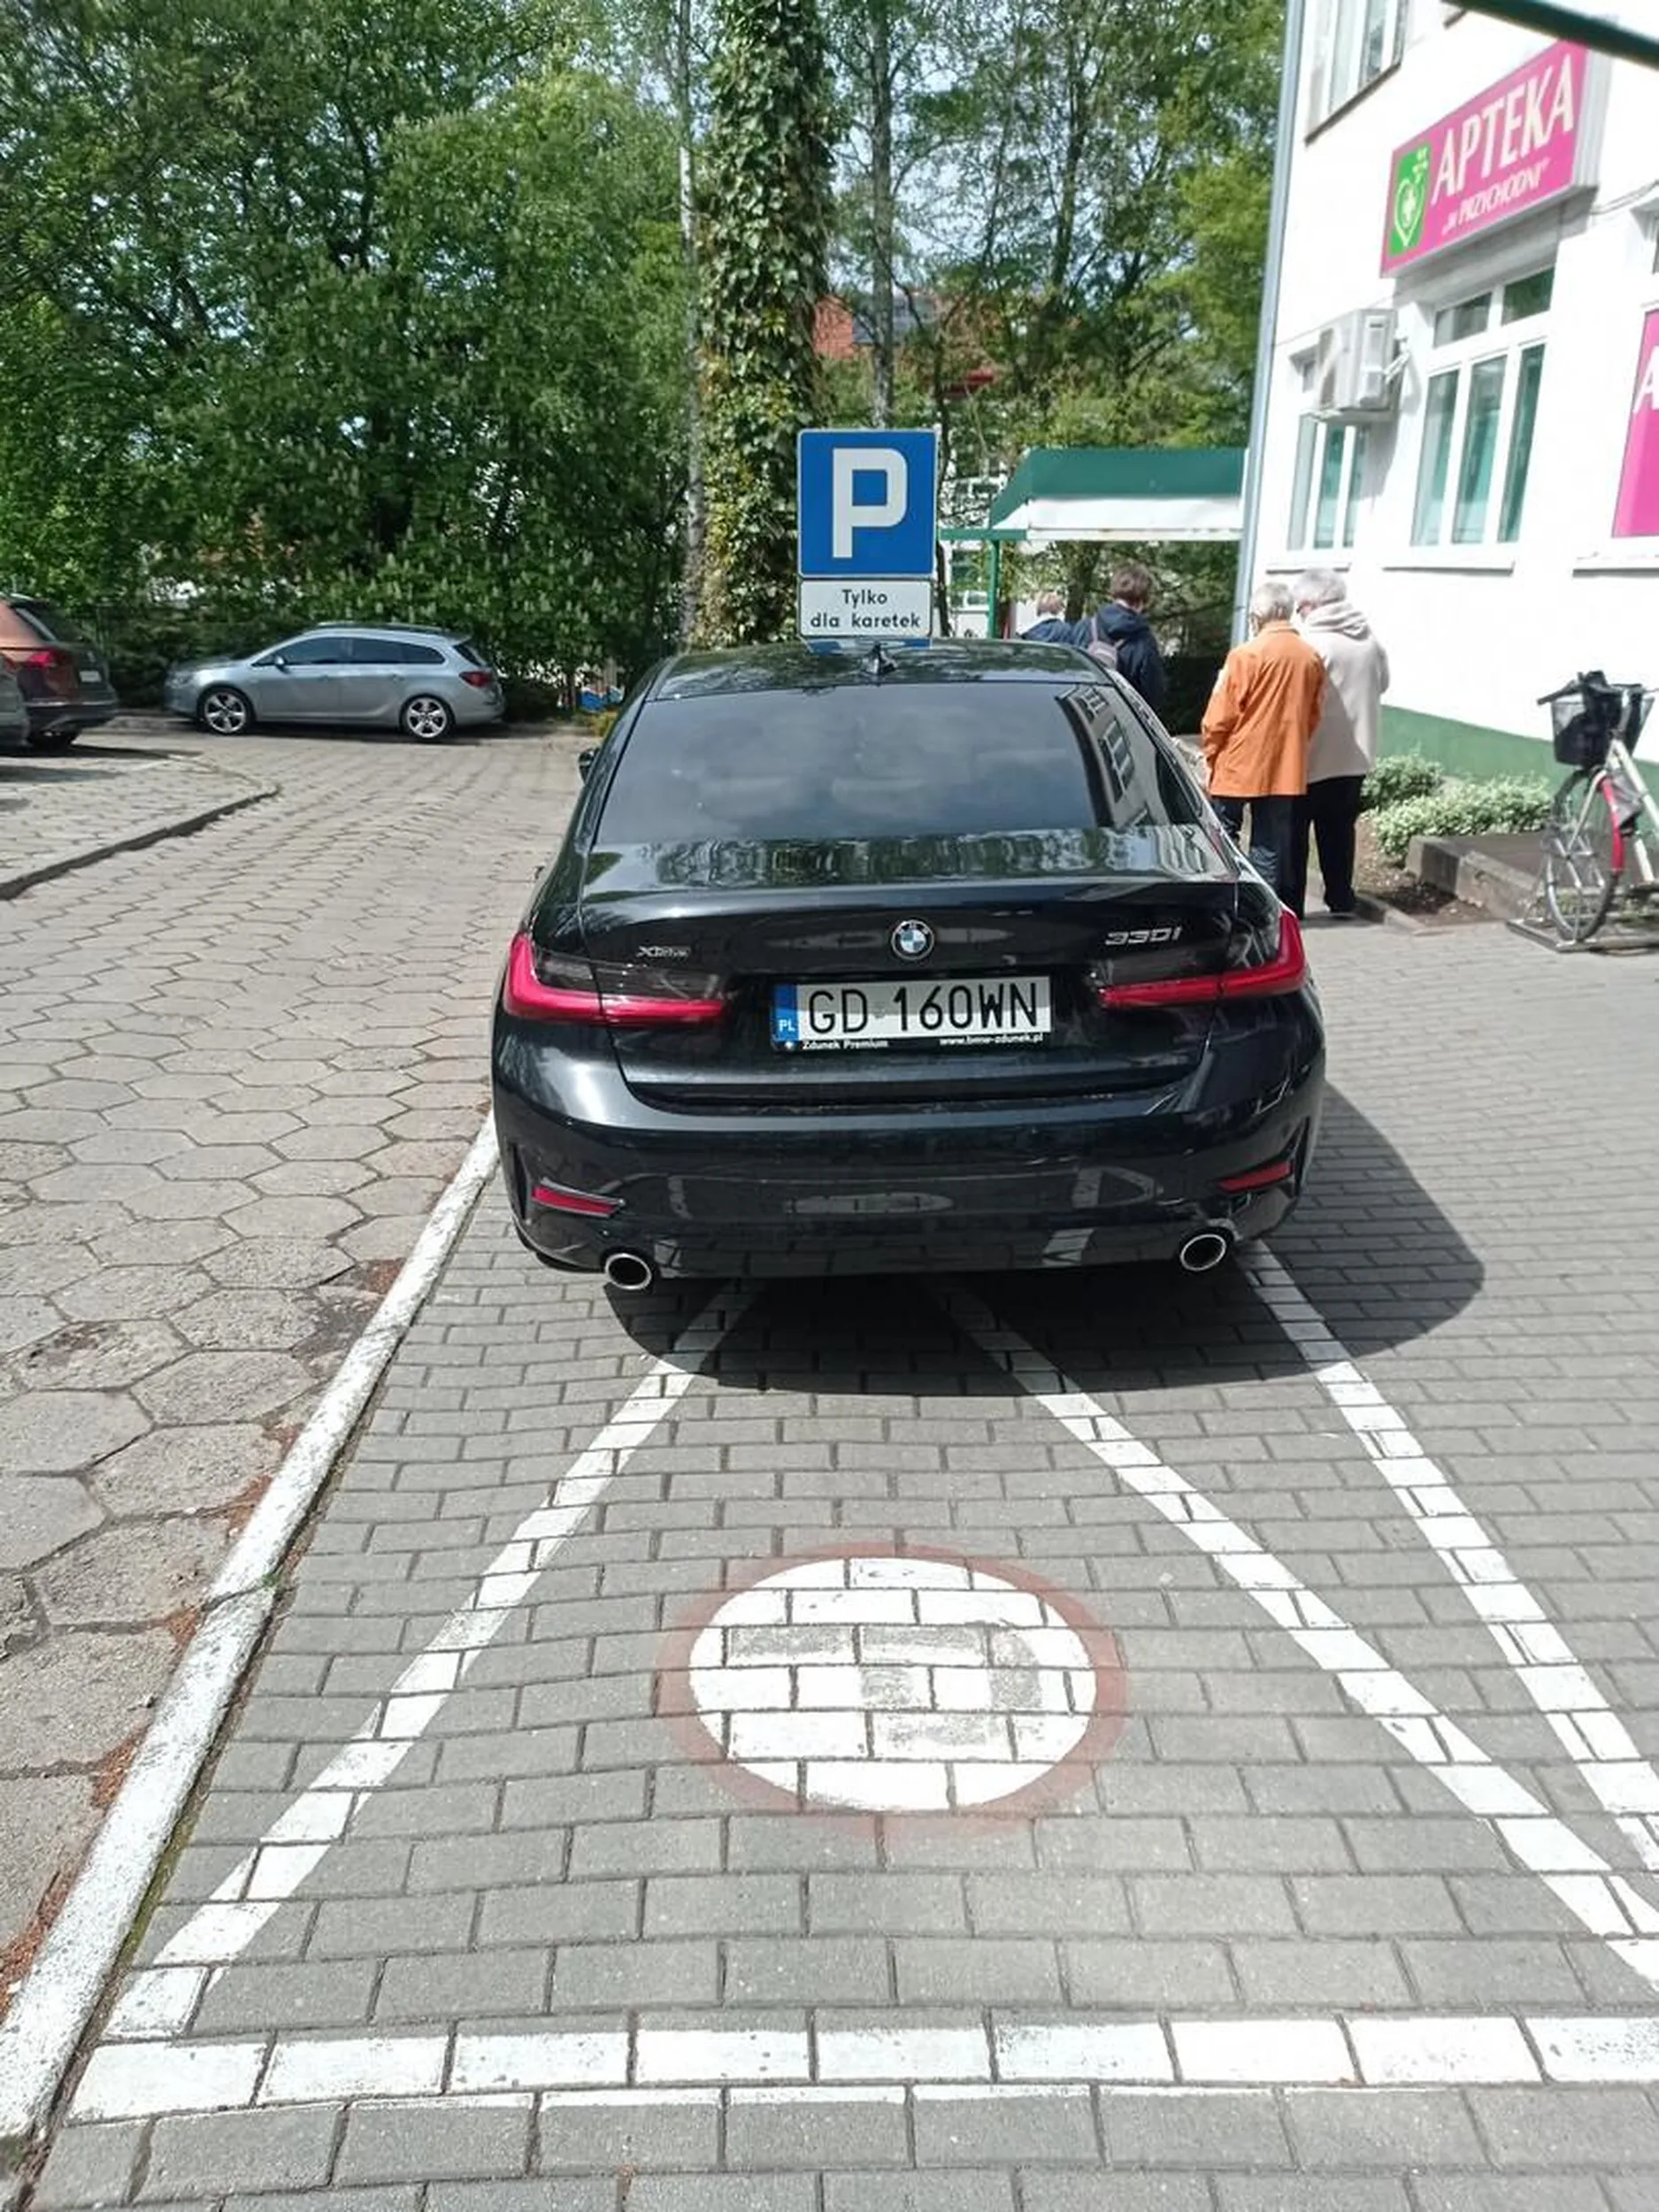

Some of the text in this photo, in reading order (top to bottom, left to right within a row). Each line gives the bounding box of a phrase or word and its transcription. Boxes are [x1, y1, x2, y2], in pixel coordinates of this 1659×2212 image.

[1430, 53, 1575, 206] APTEKA
[833, 448, 908, 558] P
[842, 588, 887, 608] Tylko
[810, 611, 920, 628] dla karetek
[779, 1018, 795, 1033] PL
[808, 982, 1037, 1034] GD 160WN
